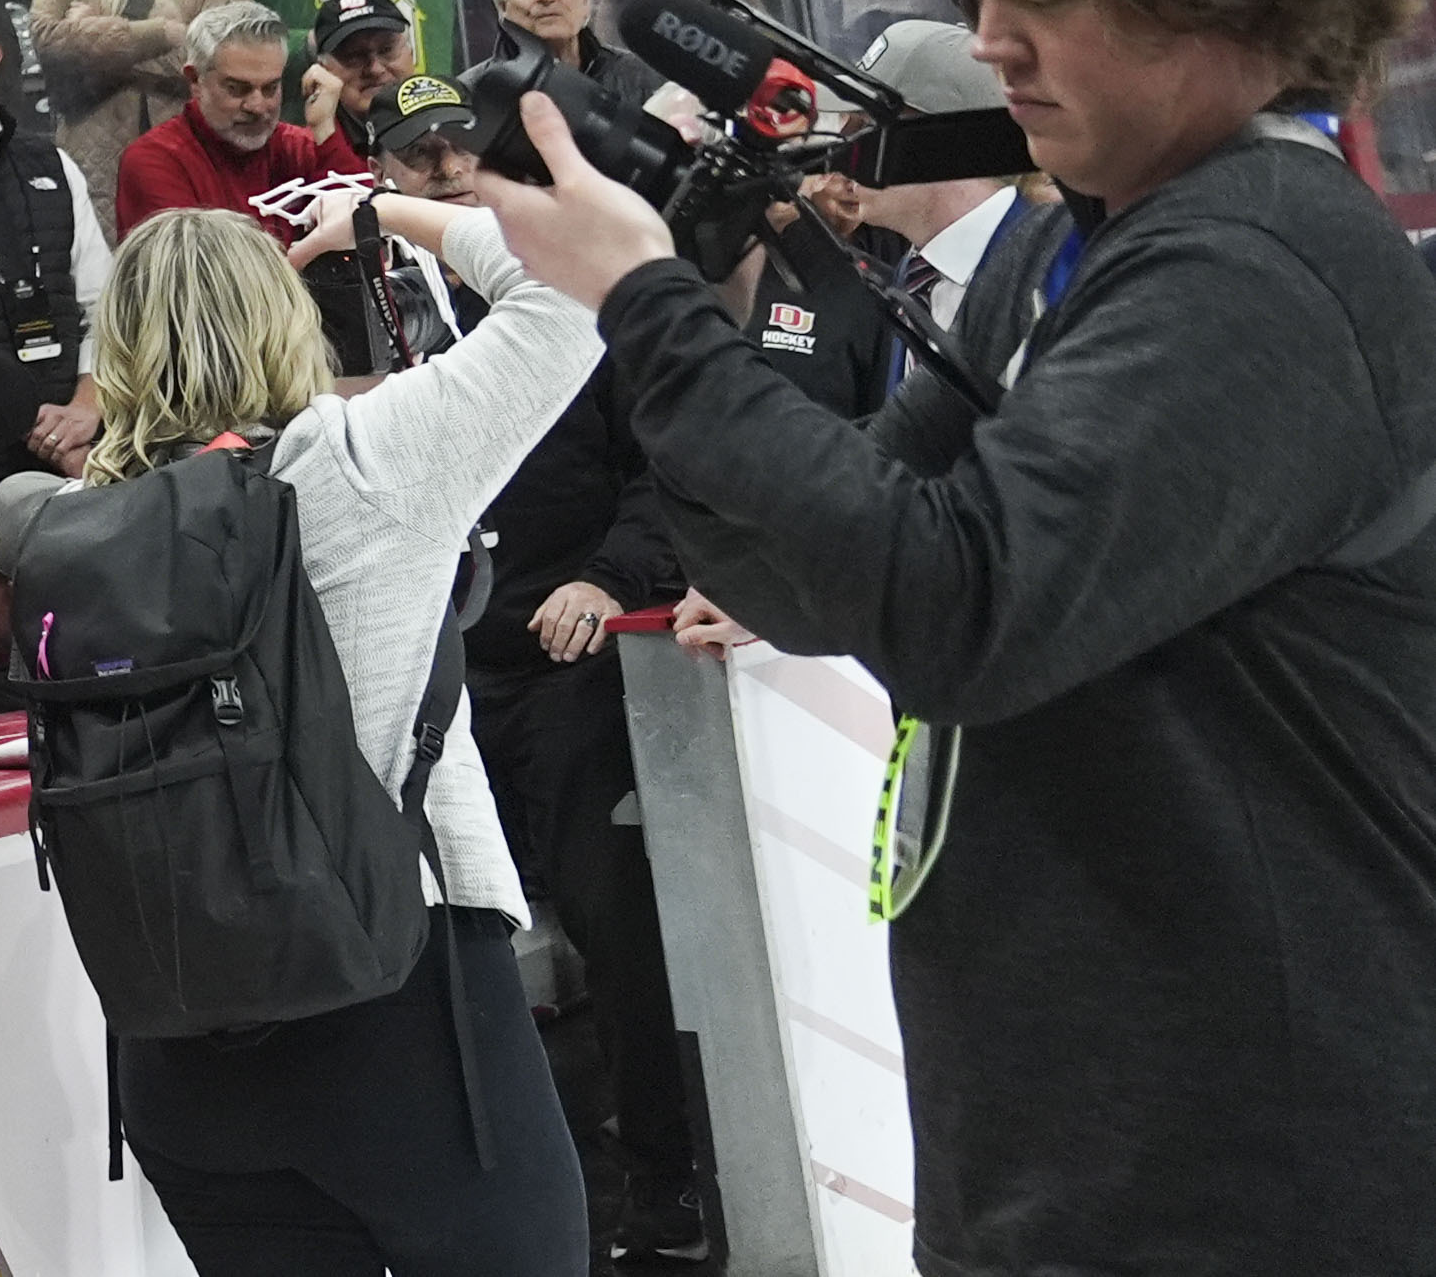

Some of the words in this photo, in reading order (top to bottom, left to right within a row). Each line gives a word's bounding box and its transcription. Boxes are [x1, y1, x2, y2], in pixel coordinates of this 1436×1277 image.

[652, 10, 751, 79] RØDE
[372, 275, 398, 338] Canon
[762, 330, 816, 348] HOCKEY
